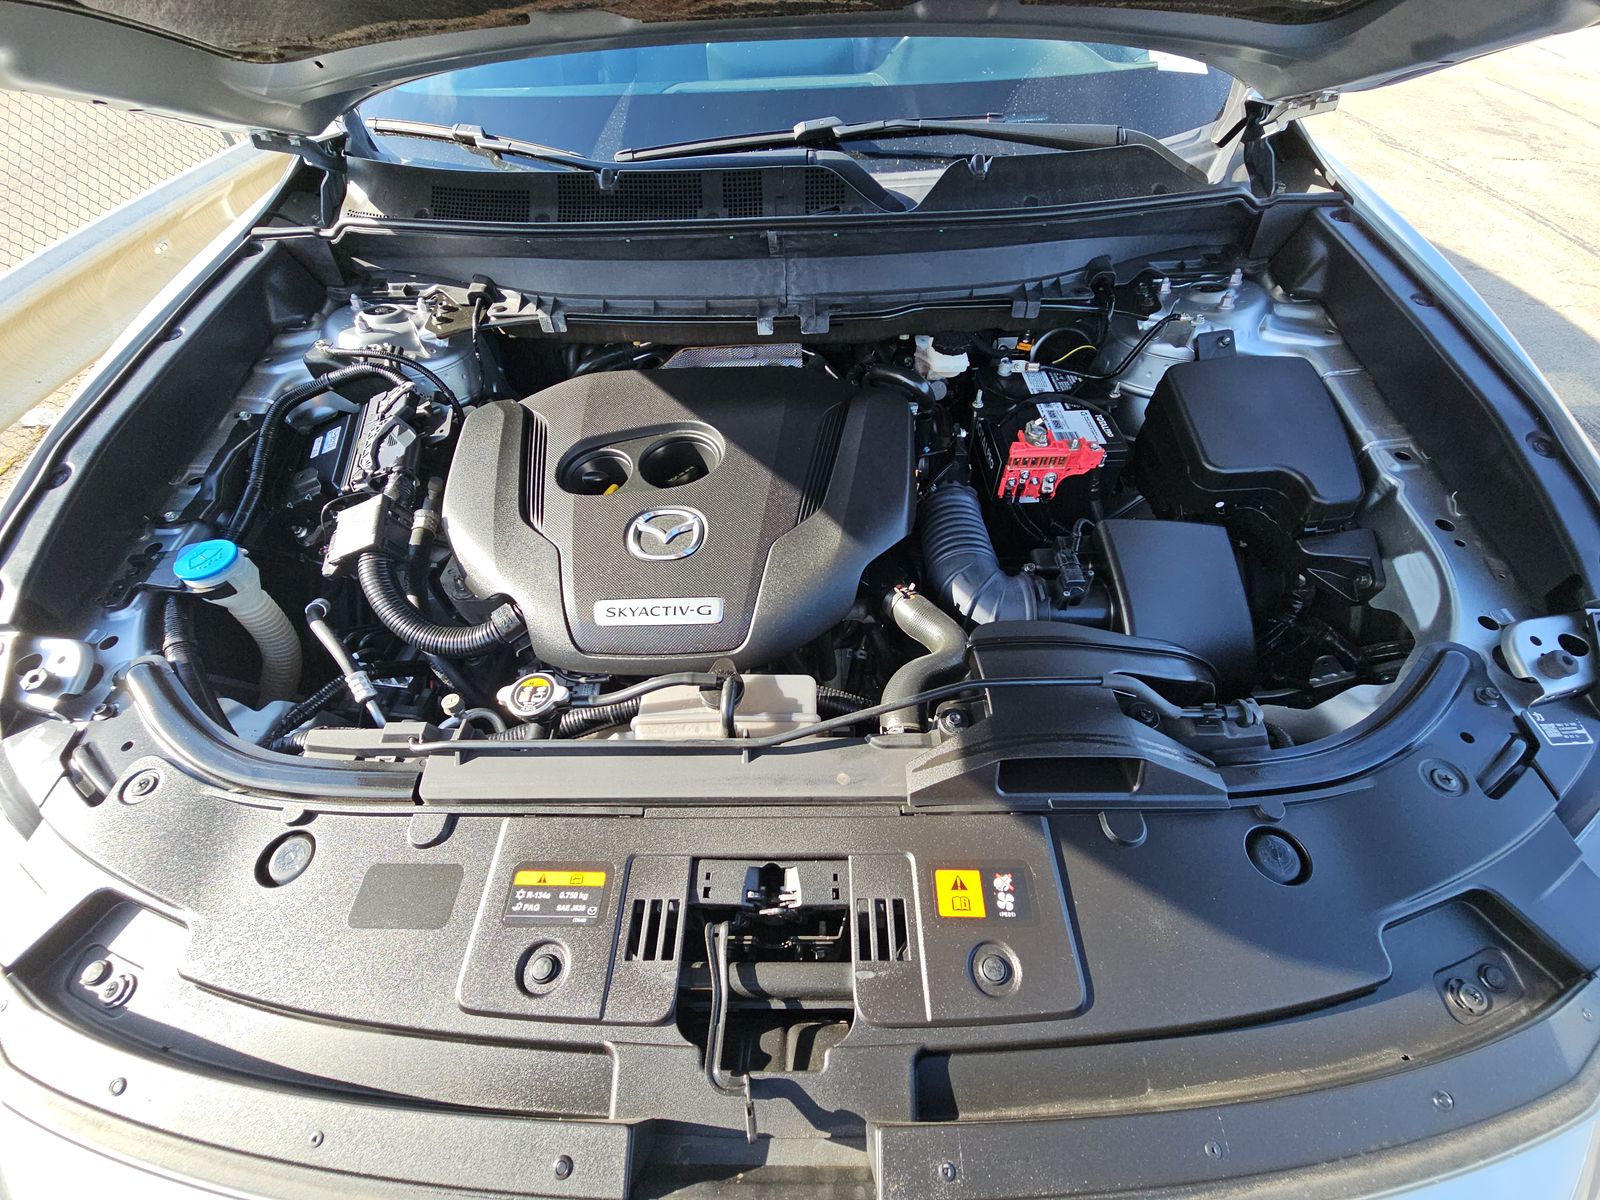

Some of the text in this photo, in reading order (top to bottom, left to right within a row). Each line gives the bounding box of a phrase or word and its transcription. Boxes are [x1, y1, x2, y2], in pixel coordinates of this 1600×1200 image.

[605, 605, 712, 618] SKYACTIV-G
[578, 891, 589, 901] kg
[522, 903, 540, 912] PAG
